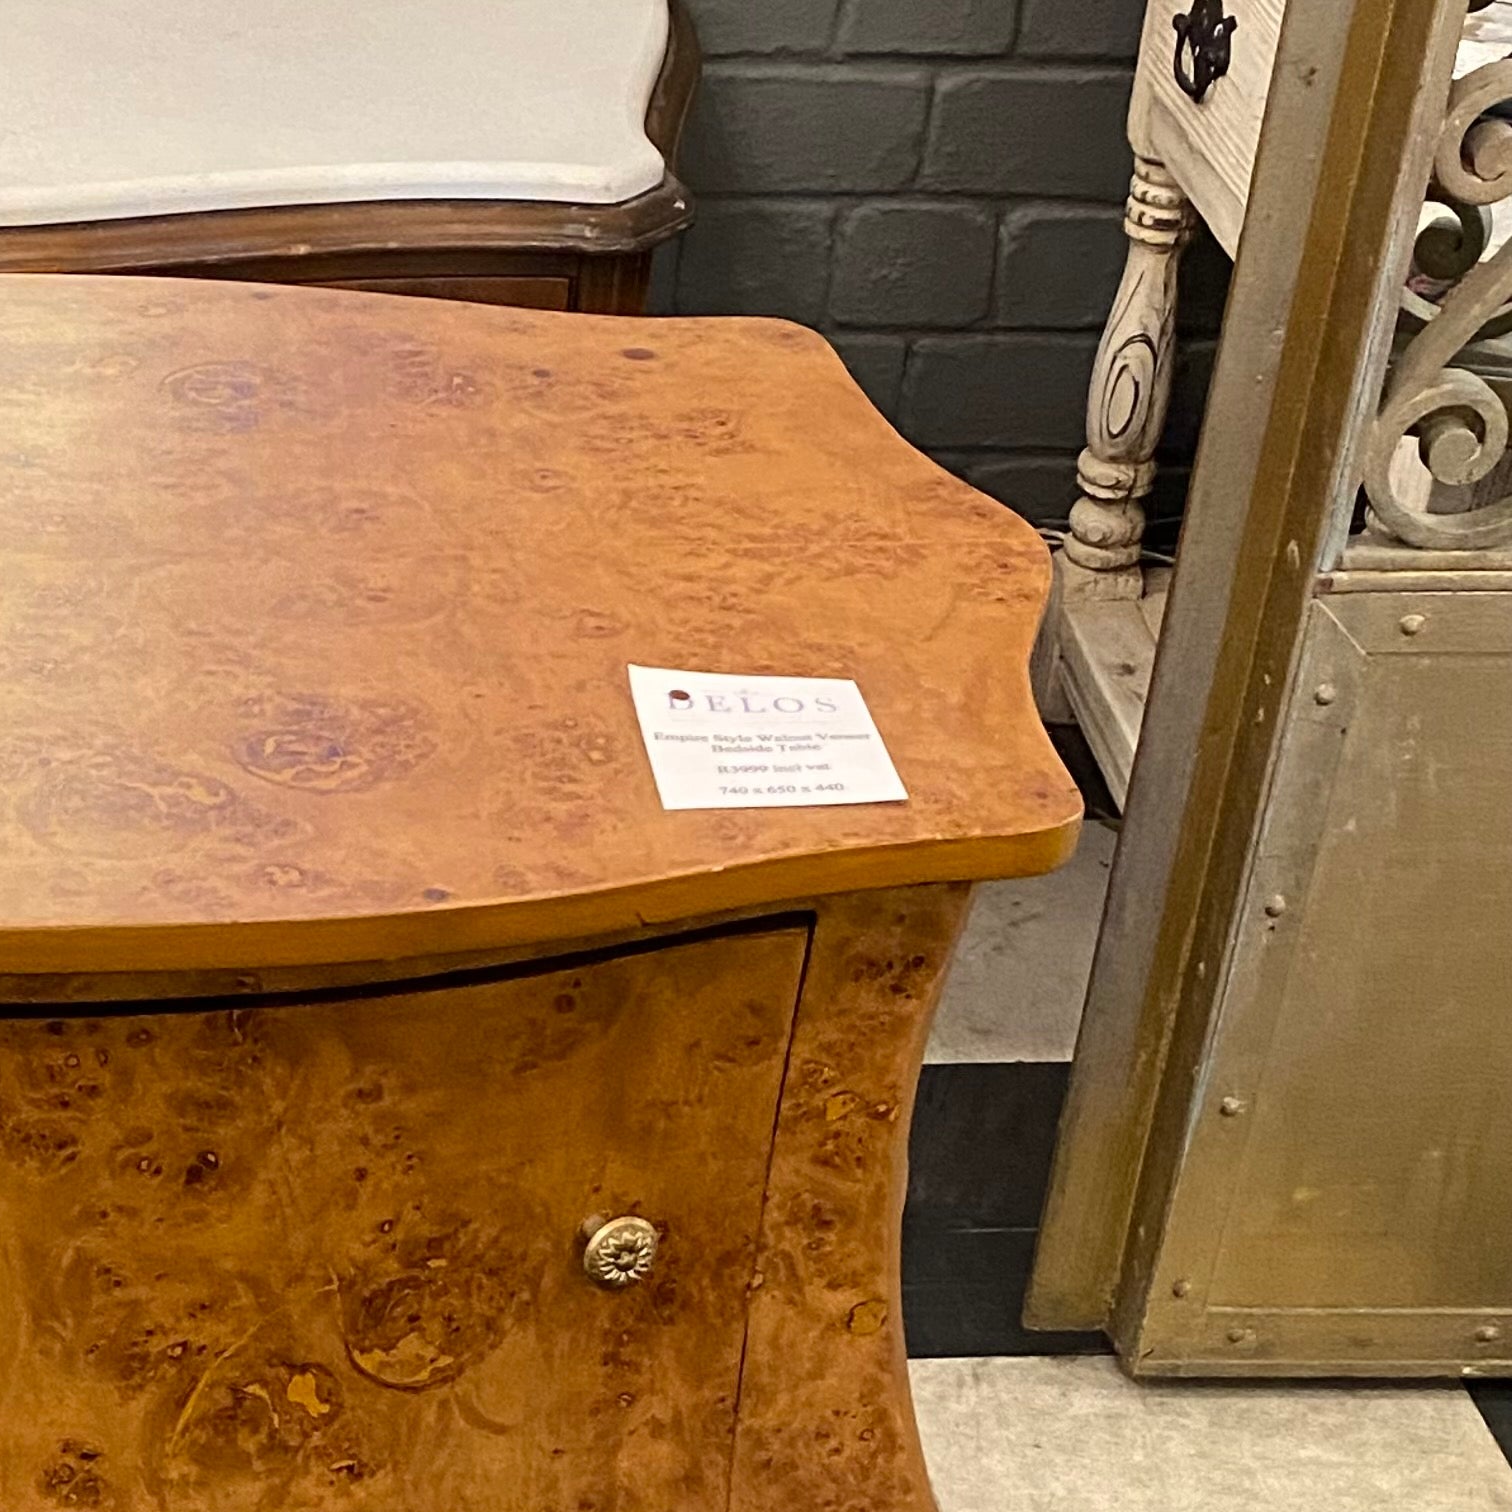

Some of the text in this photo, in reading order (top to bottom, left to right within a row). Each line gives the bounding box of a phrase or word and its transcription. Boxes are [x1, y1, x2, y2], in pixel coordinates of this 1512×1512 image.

[653, 731, 709, 743] Empire
[712, 733, 752, 743] Style
[755, 733, 813, 742] Walnut
[711, 743, 822, 753] Bedside Table
[718, 785, 749, 795] 740
[767, 785, 797, 794] 650
[800, 785, 811, 793] x
[815, 782, 845, 792] 440
